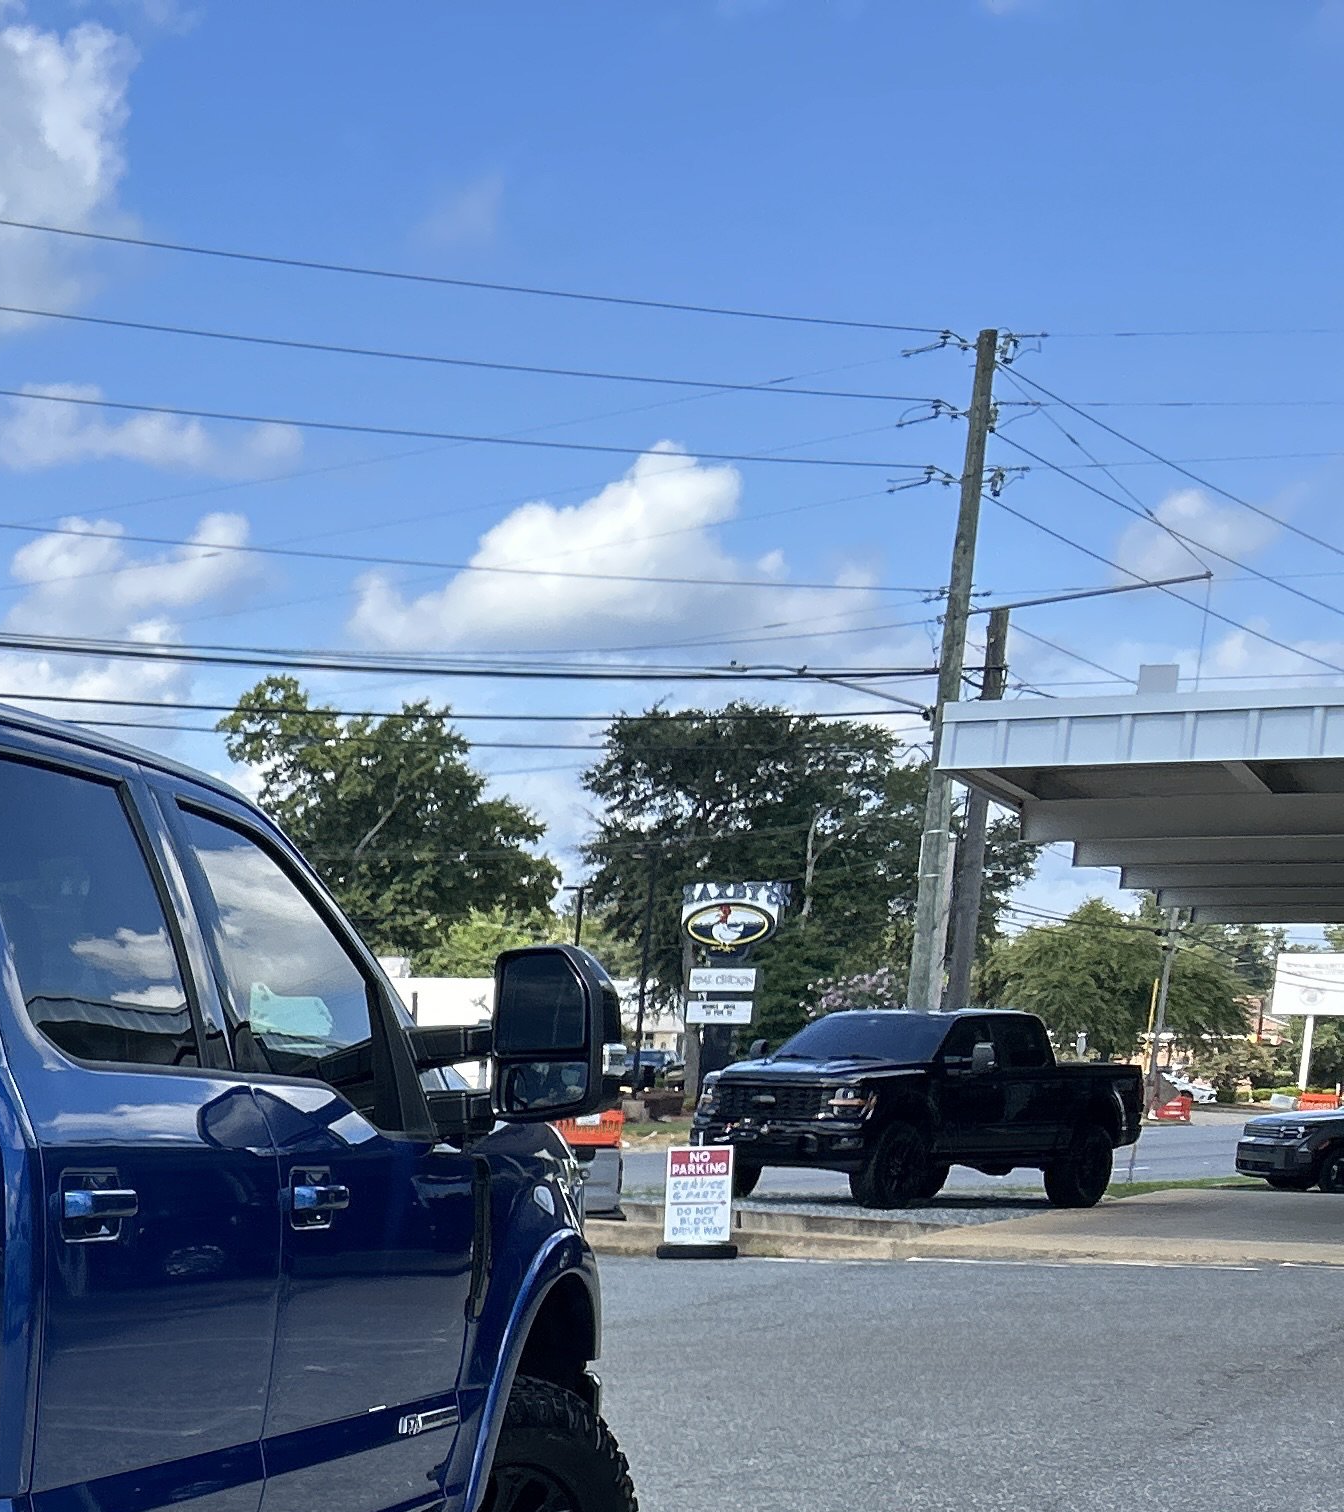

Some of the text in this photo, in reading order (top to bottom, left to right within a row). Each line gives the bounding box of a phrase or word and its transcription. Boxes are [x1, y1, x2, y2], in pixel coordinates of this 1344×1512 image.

[689, 1151, 711, 1163] NO
[672, 1162, 727, 1175] PARKING
[672, 1179, 725, 1190] SERVICE
[685, 1190, 725, 1200] PARTS
[676, 1206, 719, 1216] DO NOT
[679, 1216, 715, 1226] BLOCK
